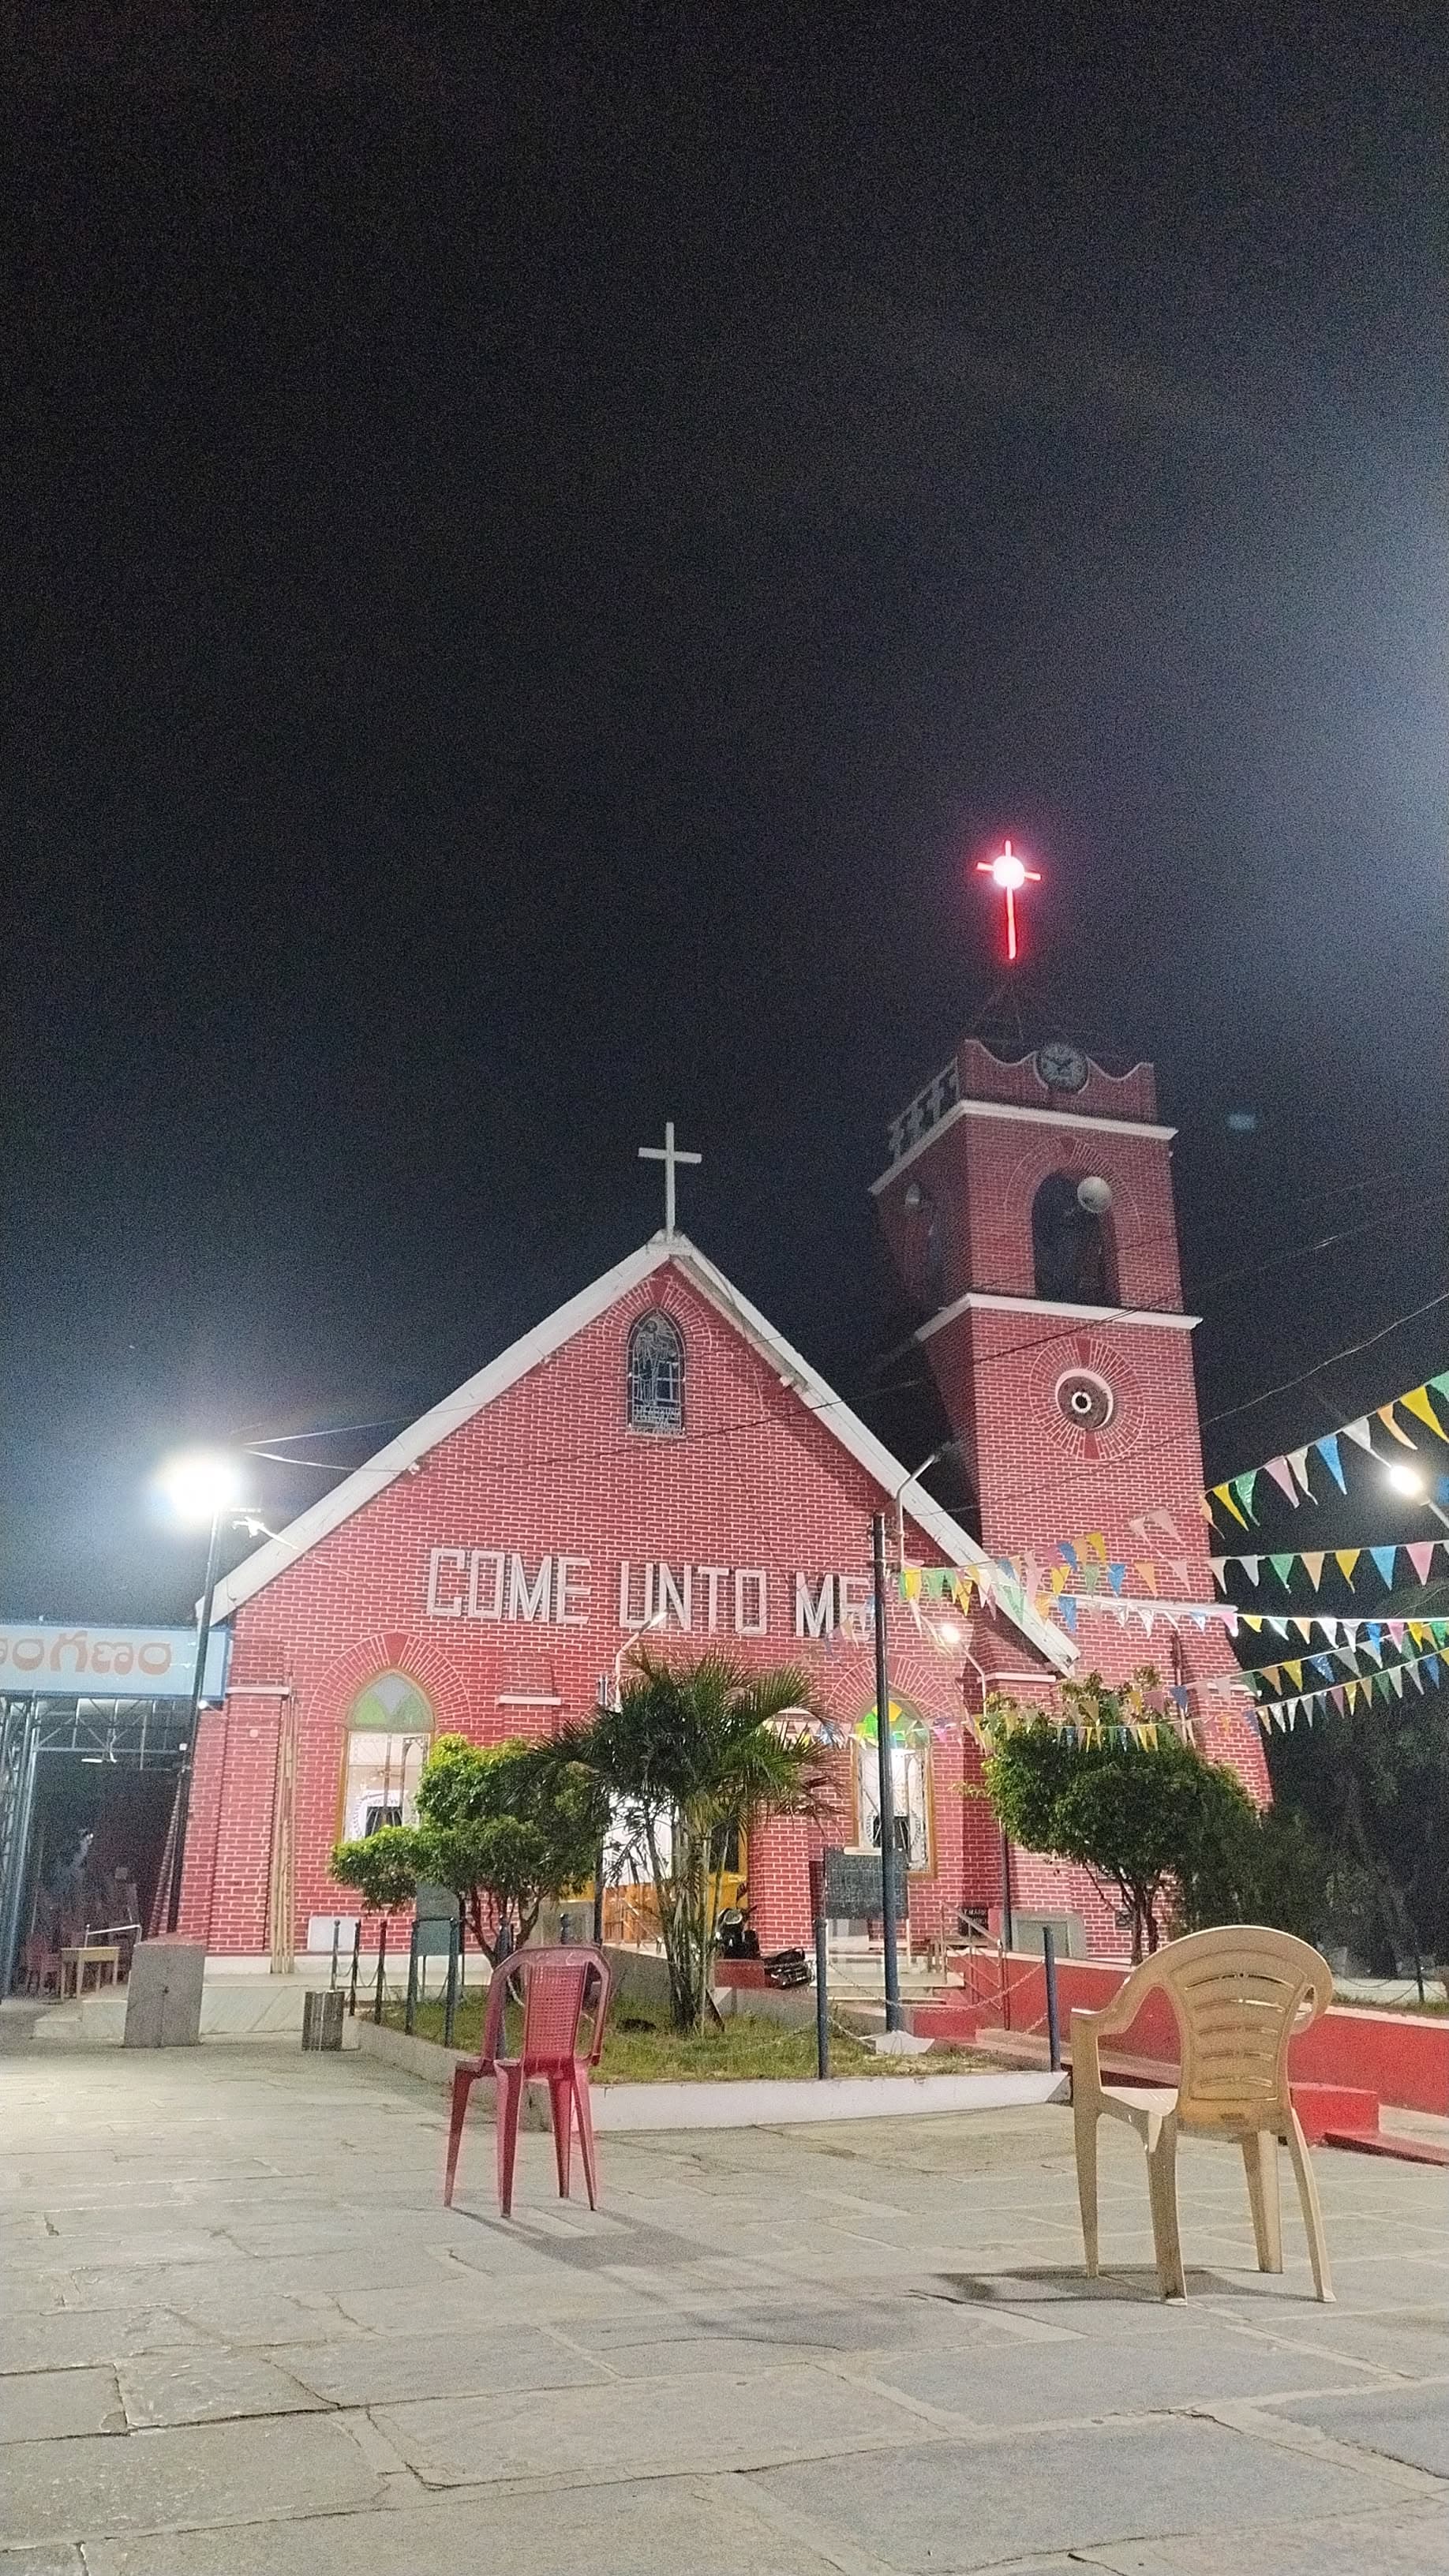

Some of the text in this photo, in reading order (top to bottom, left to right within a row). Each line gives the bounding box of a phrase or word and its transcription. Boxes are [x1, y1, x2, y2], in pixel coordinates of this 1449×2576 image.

[425, 1548, 871, 1642] COME UNTO ME
